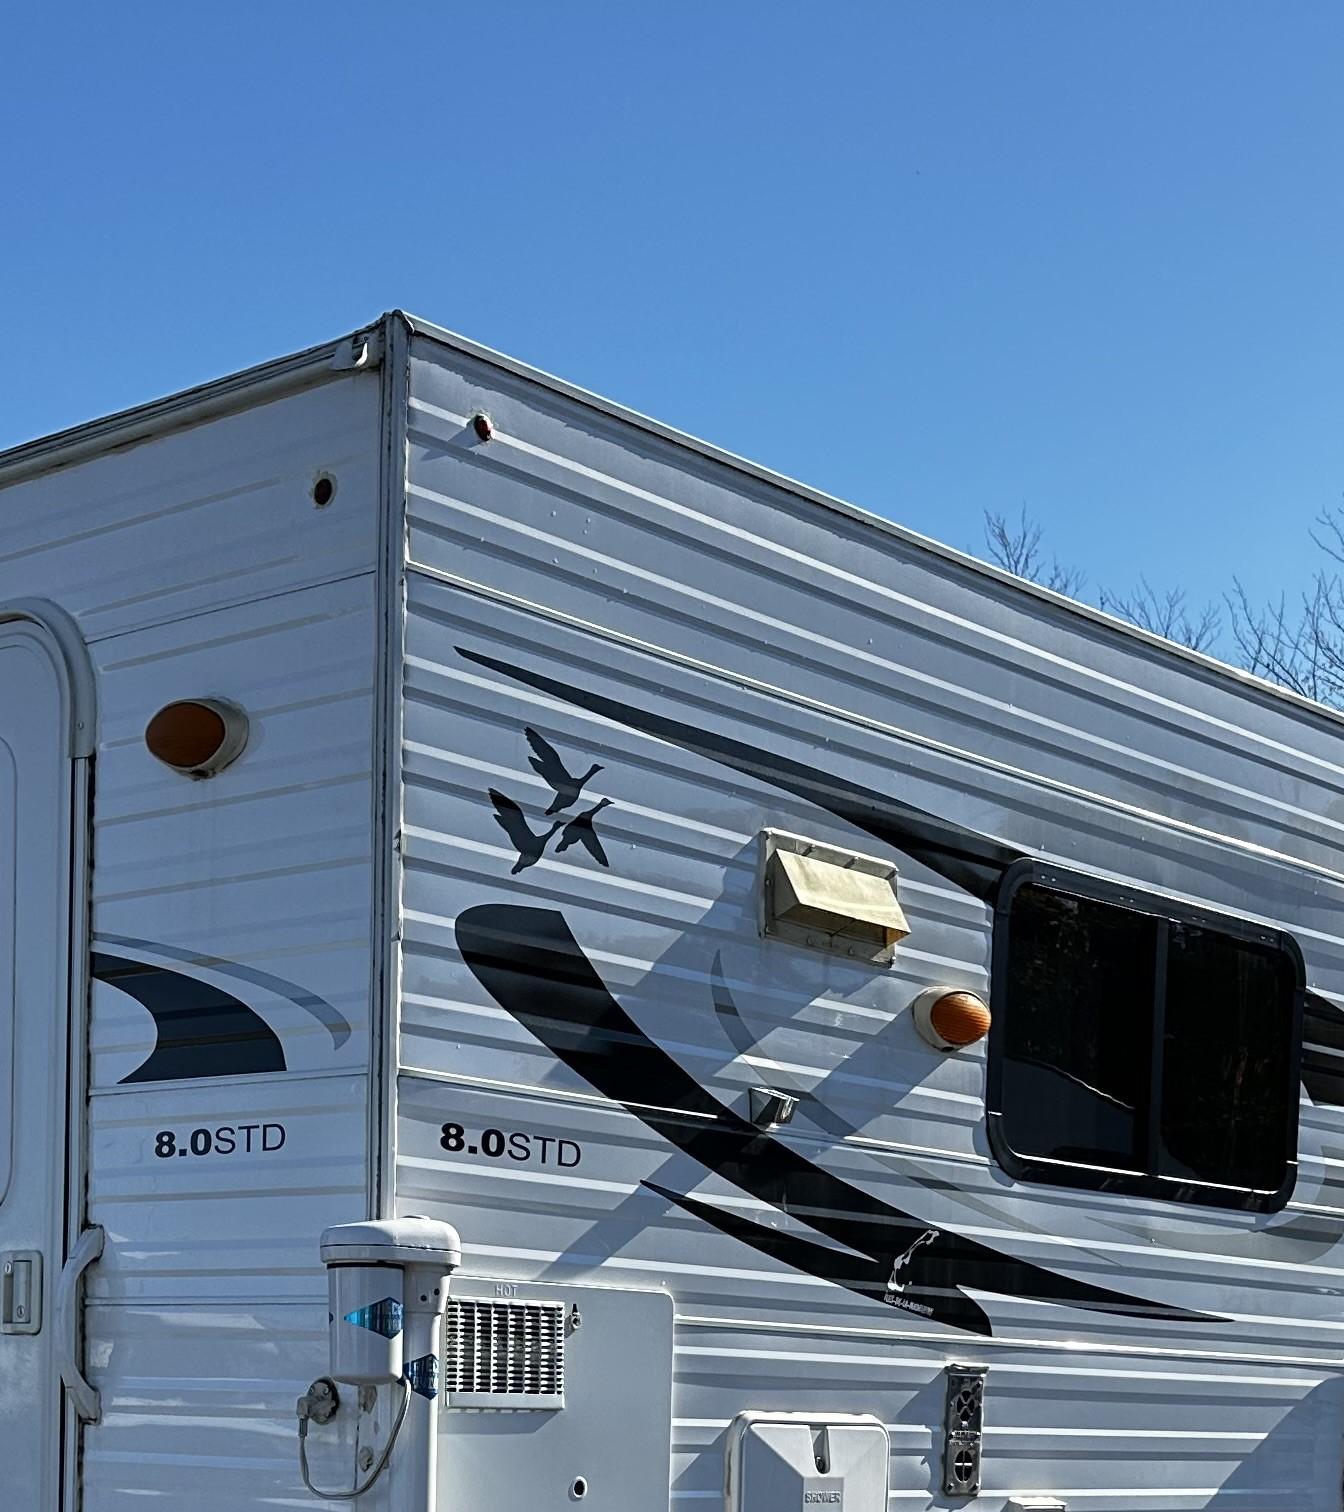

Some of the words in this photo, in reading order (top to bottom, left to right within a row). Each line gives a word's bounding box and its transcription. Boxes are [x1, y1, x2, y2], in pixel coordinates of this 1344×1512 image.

[155, 1123, 286, 1159] 8.0STD
[440, 1122, 581, 1168] 8.0STD
[495, 1283, 519, 1297] HOT
[804, 1490, 841, 1504] SHOWER
